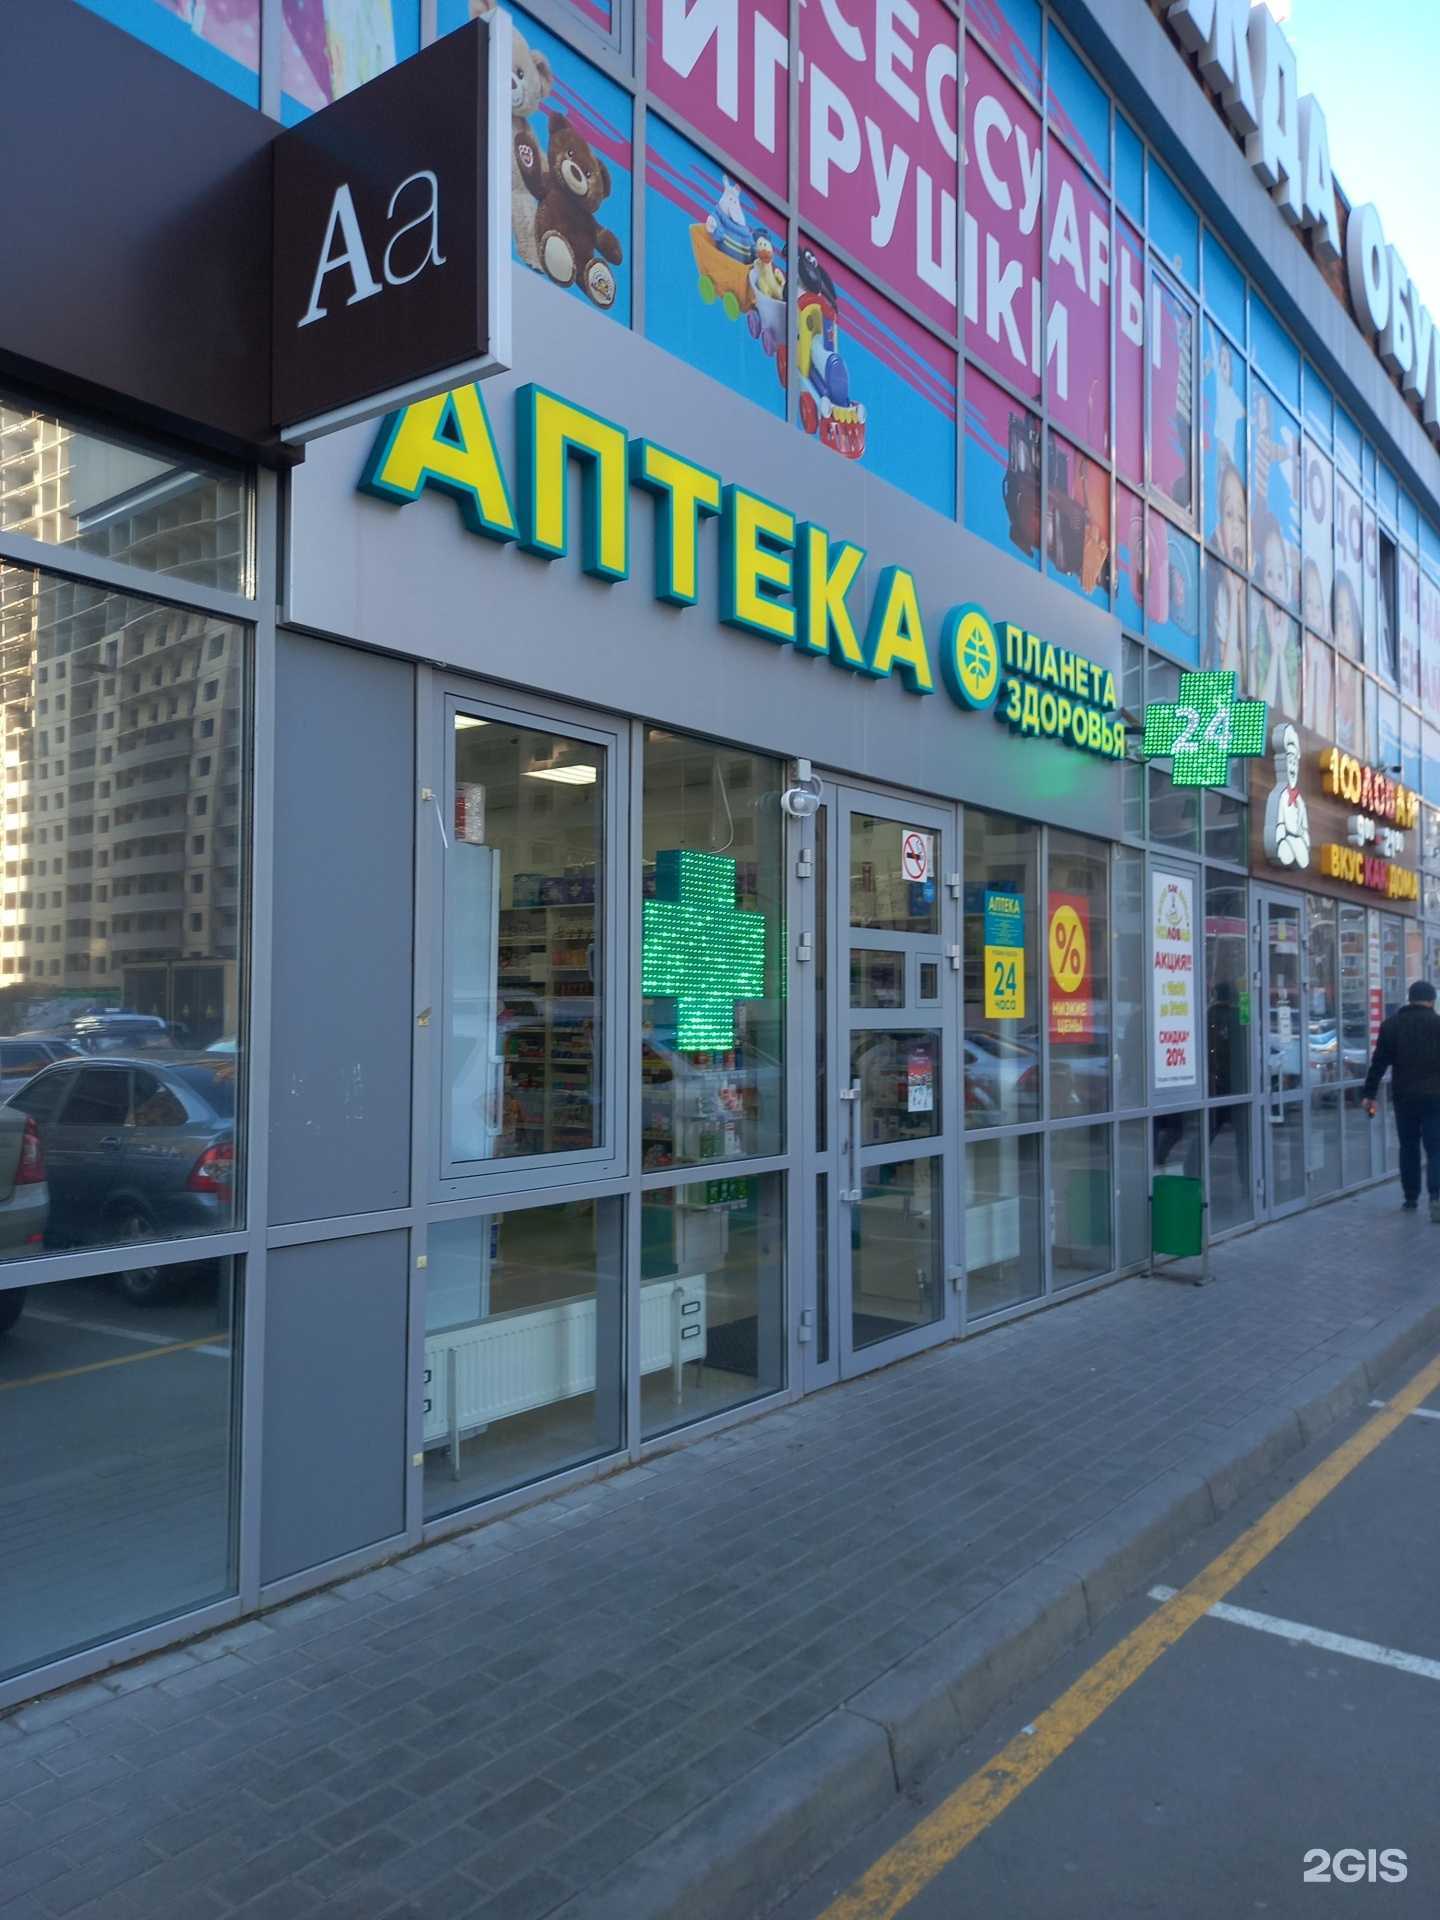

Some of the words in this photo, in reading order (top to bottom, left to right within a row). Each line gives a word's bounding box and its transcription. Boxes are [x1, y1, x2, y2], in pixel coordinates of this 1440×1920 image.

[1347, 202, 1440, 436] ОБУ
[358, 382, 935, 695] АПТЕКА
[1003, 622, 1117, 707] ПЛАНЕТА
[1004, 681, 1126, 760] ЗДОРОВЬЯ
[1171, 689, 1234, 754] 24
[1327, 843, 1364, 885] ВКУС
[987, 895, 1021, 915] АПТЕКА
[993, 960, 1017, 997] 24
[1051, 1001, 1088, 1017] НИЗКИЕ
[1057, 1017, 1083, 1035] ЦЕНЫ
